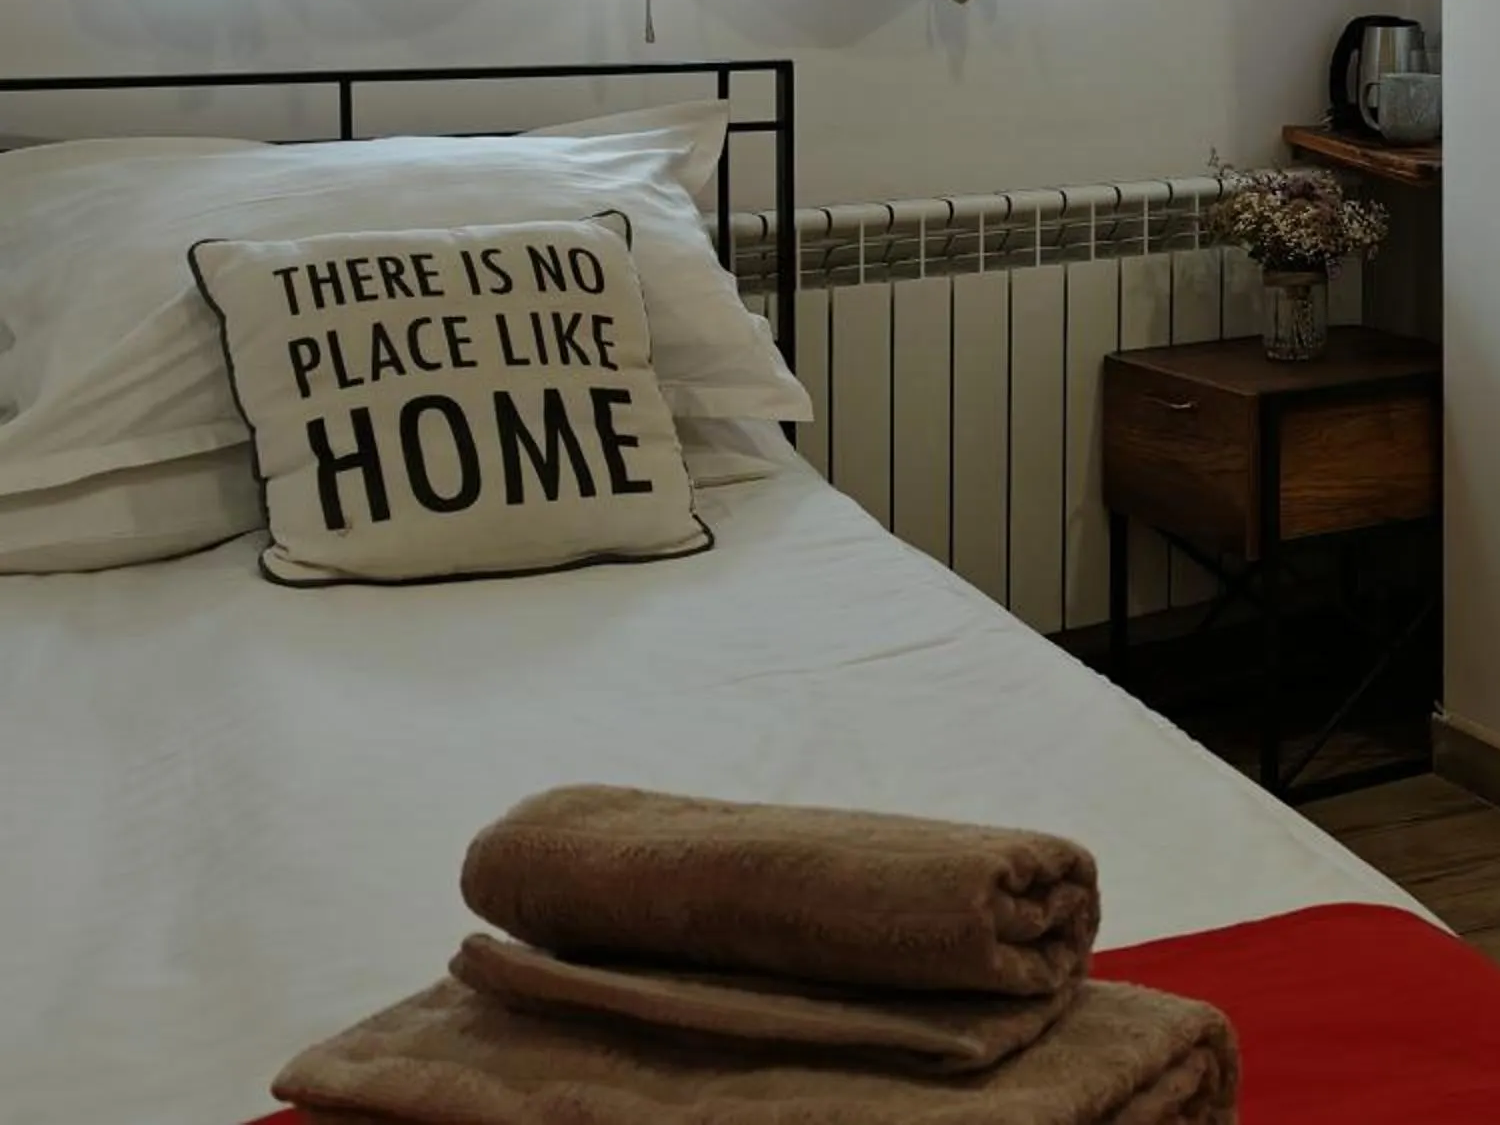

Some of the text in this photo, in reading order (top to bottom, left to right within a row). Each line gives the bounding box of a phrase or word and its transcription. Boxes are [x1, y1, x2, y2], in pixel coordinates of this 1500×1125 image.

[273, 244, 606, 316] THERE IS NO
[288, 312, 619, 398] PLACE LIKE
[306, 388, 653, 530] HOME
